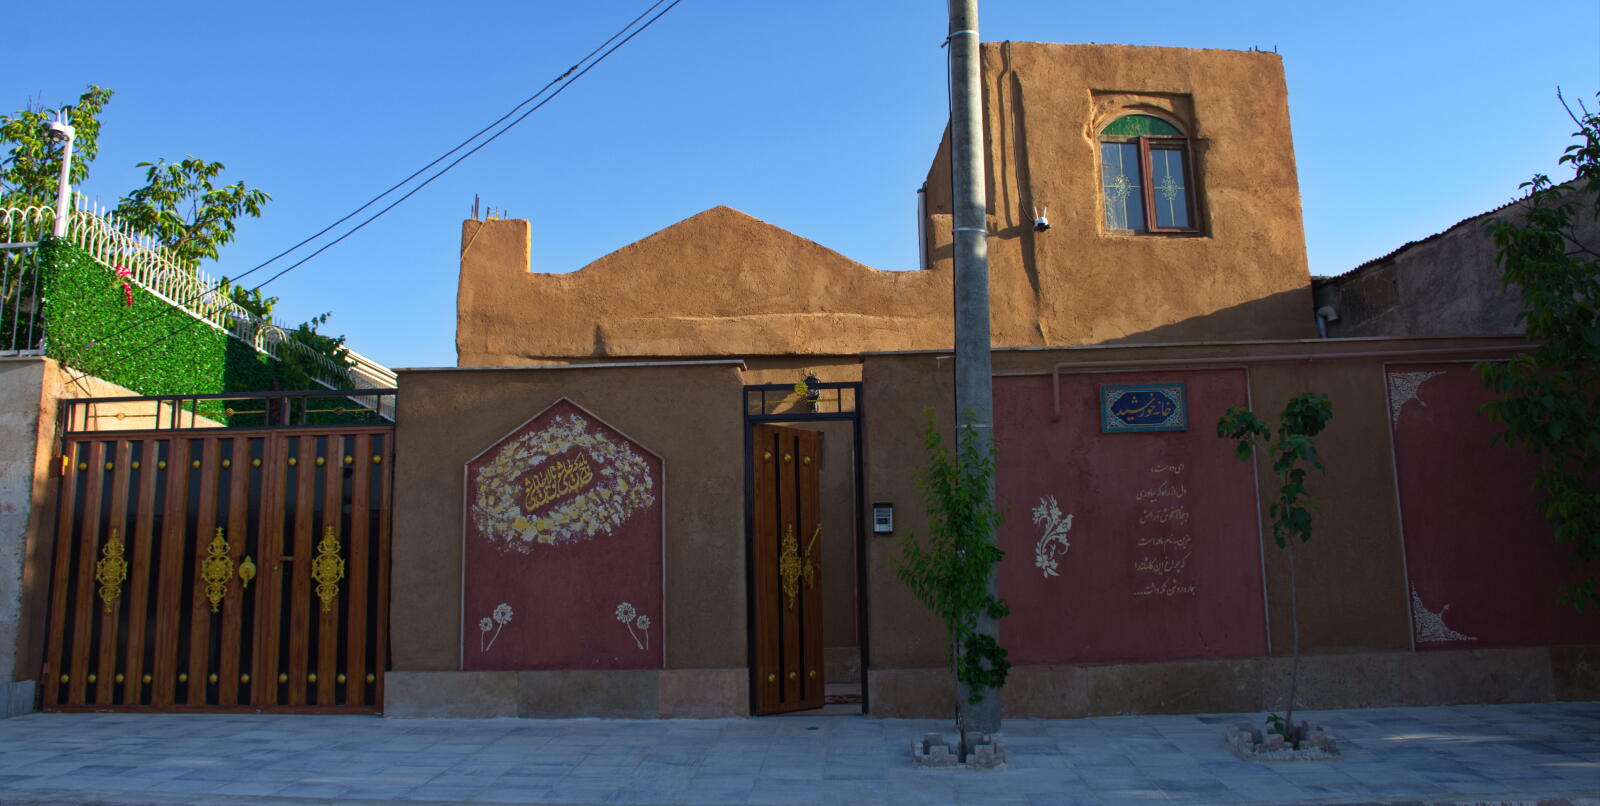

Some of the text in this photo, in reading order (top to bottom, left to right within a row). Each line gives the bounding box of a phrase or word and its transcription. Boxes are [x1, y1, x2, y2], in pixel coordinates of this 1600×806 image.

[1114, 393, 1172, 420] خانه خورشید
[1174, 464, 1184, 474] ای
[1176, 484, 1187, 498] دل
[1138, 537, 1155, 546] است
[1154, 560, 1164, 576] این
[1164, 556, 1181, 574] چراغ
